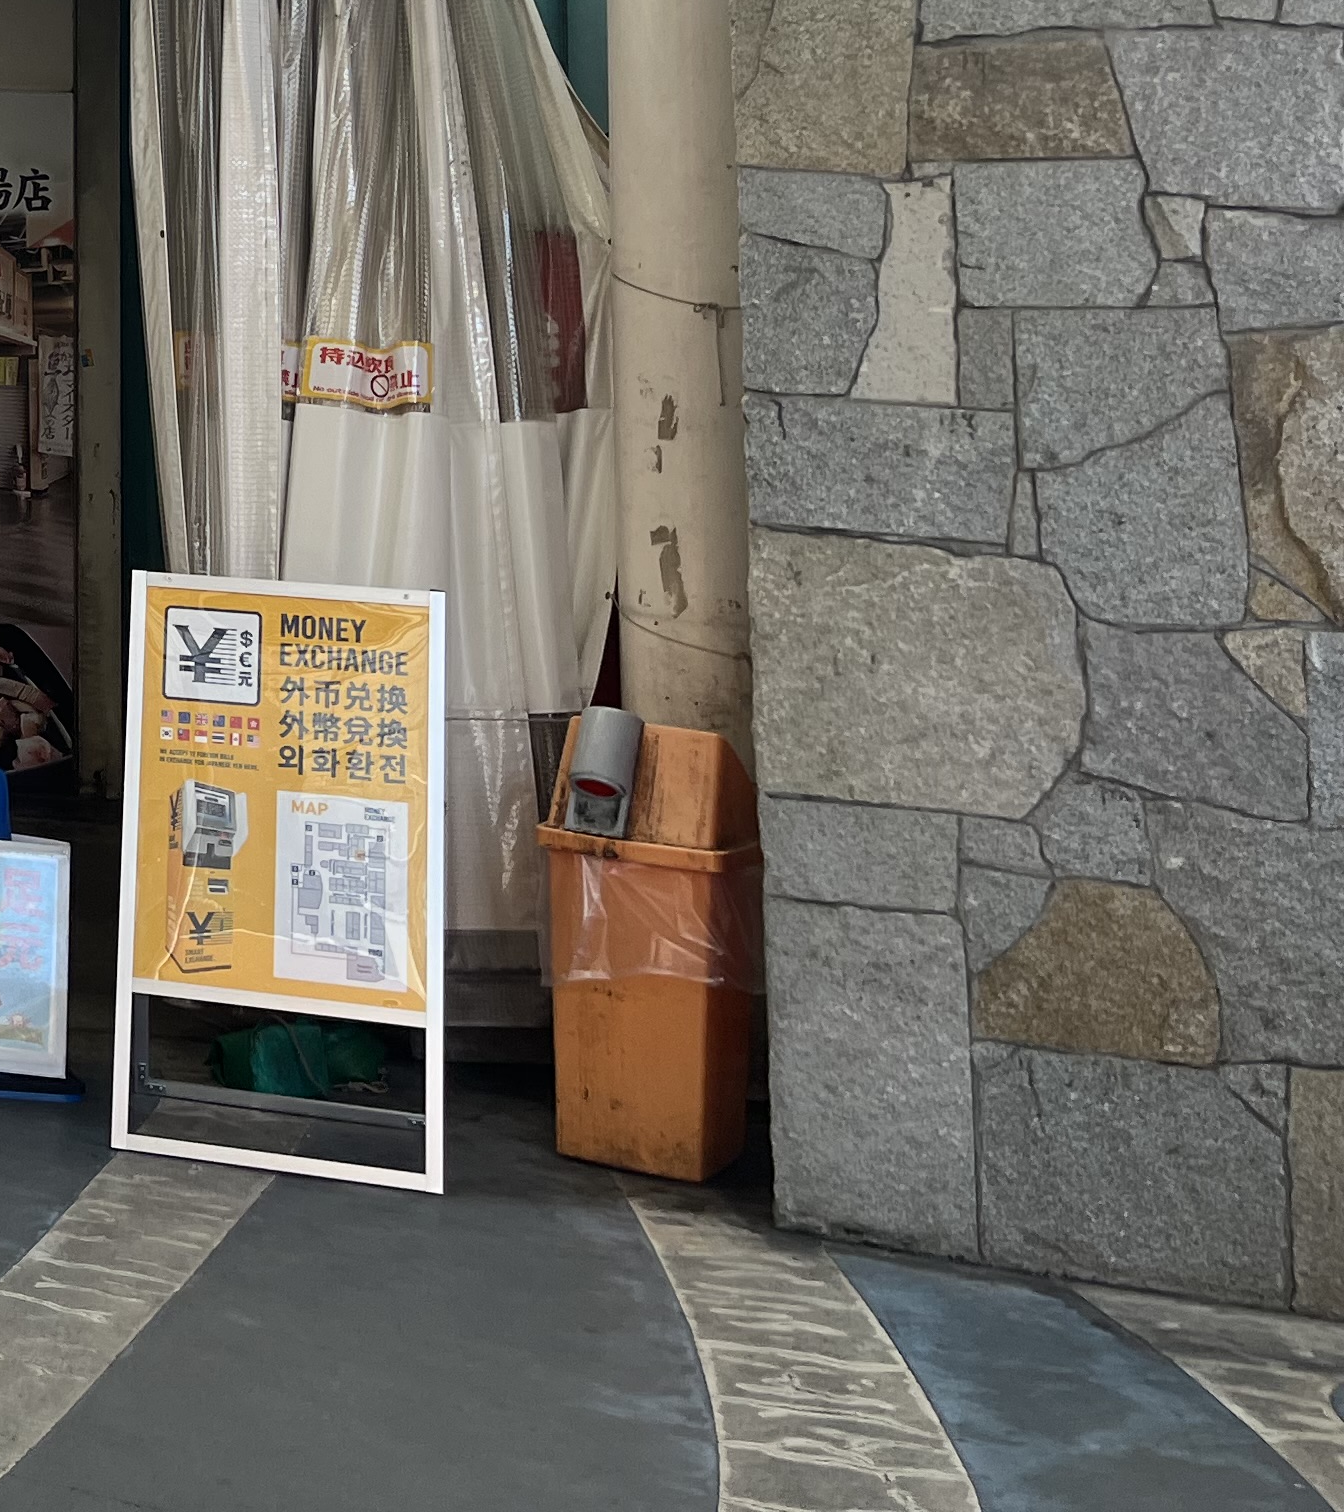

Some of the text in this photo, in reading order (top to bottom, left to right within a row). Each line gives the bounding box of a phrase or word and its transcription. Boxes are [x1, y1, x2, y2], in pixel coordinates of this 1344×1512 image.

[280, 613, 367, 643] MONEY
[279, 643, 409, 677] EXCHANGE
[238, 671, 253, 687] 元
[279, 676, 409, 714] 外币兑换
[278, 745, 406, 784] 외화환전
[291, 799, 329, 815] MAP
